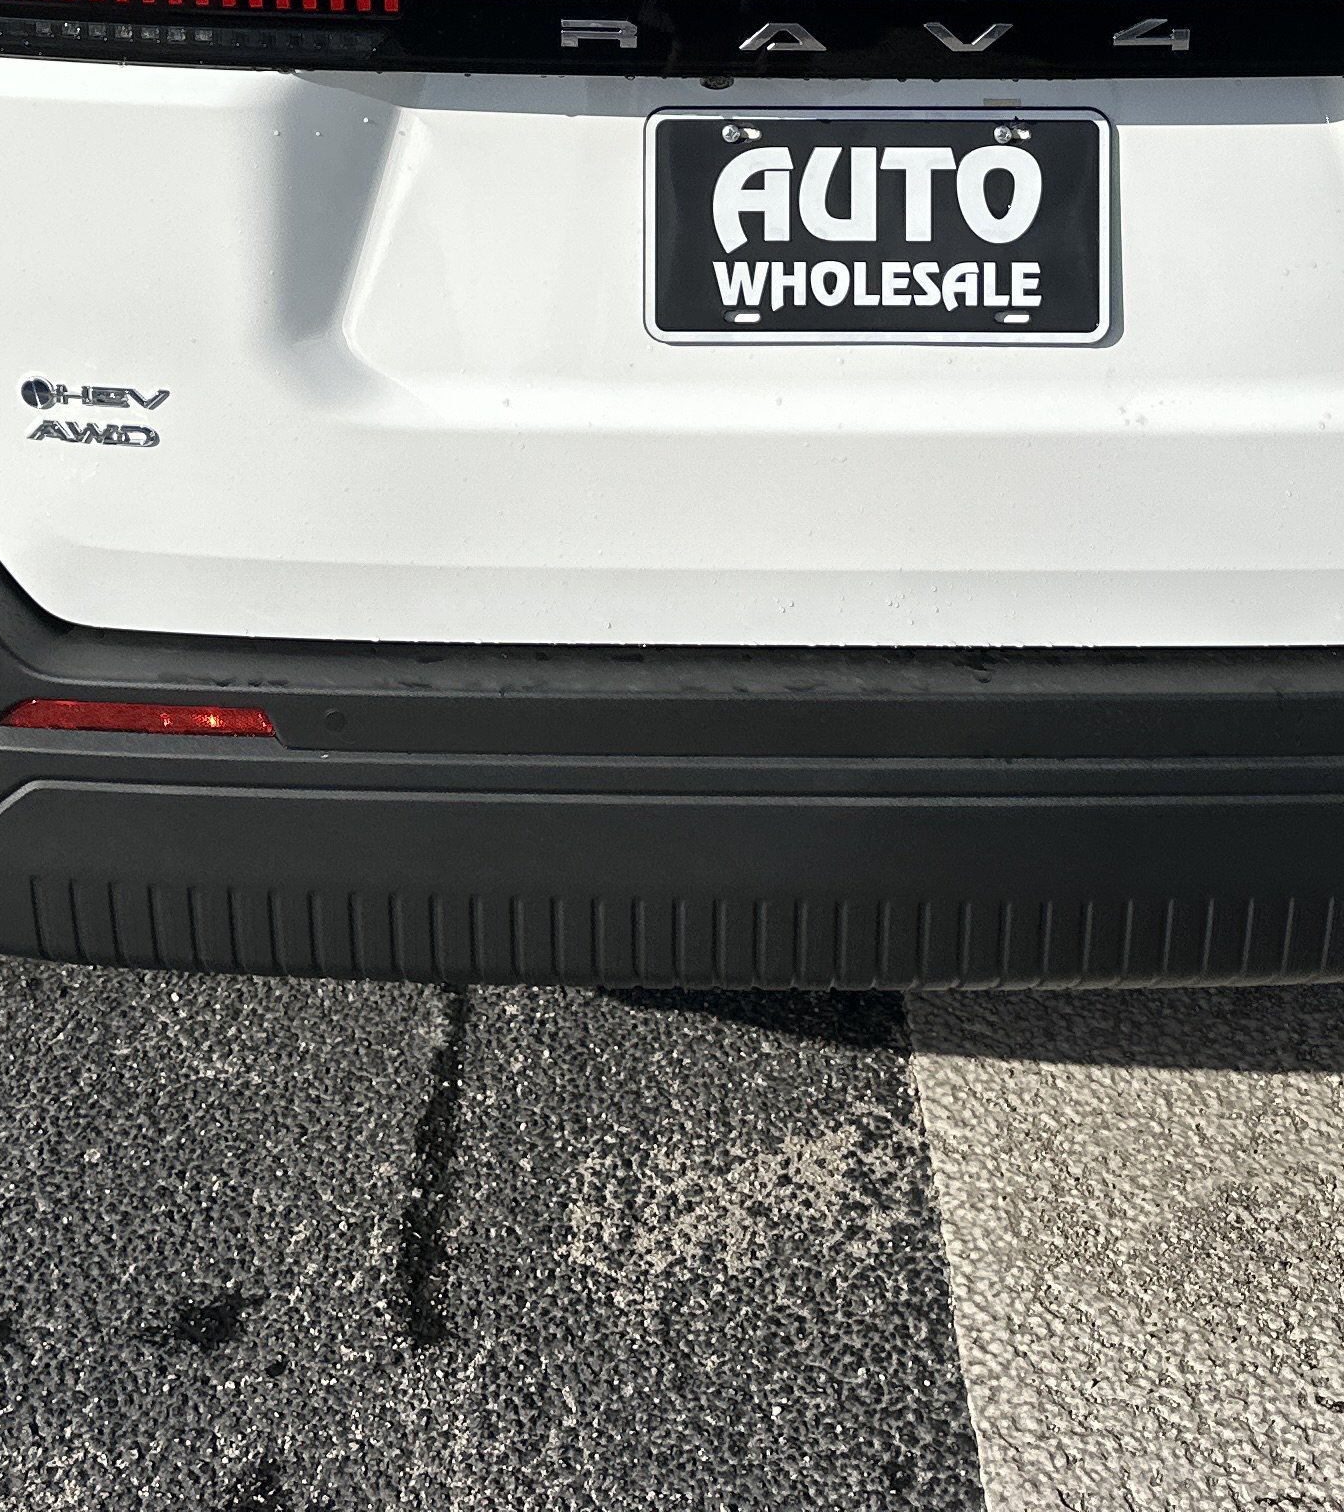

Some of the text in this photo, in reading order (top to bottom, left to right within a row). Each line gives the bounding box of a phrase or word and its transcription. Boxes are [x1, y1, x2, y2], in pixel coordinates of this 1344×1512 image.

[560, 18, 1190, 53] RAV4
[712, 145, 1043, 254] AUTO
[712, 260, 1043, 312] WHOLESALE
[55, 383, 171, 411] HEV
[25, 419, 161, 448] AWD
